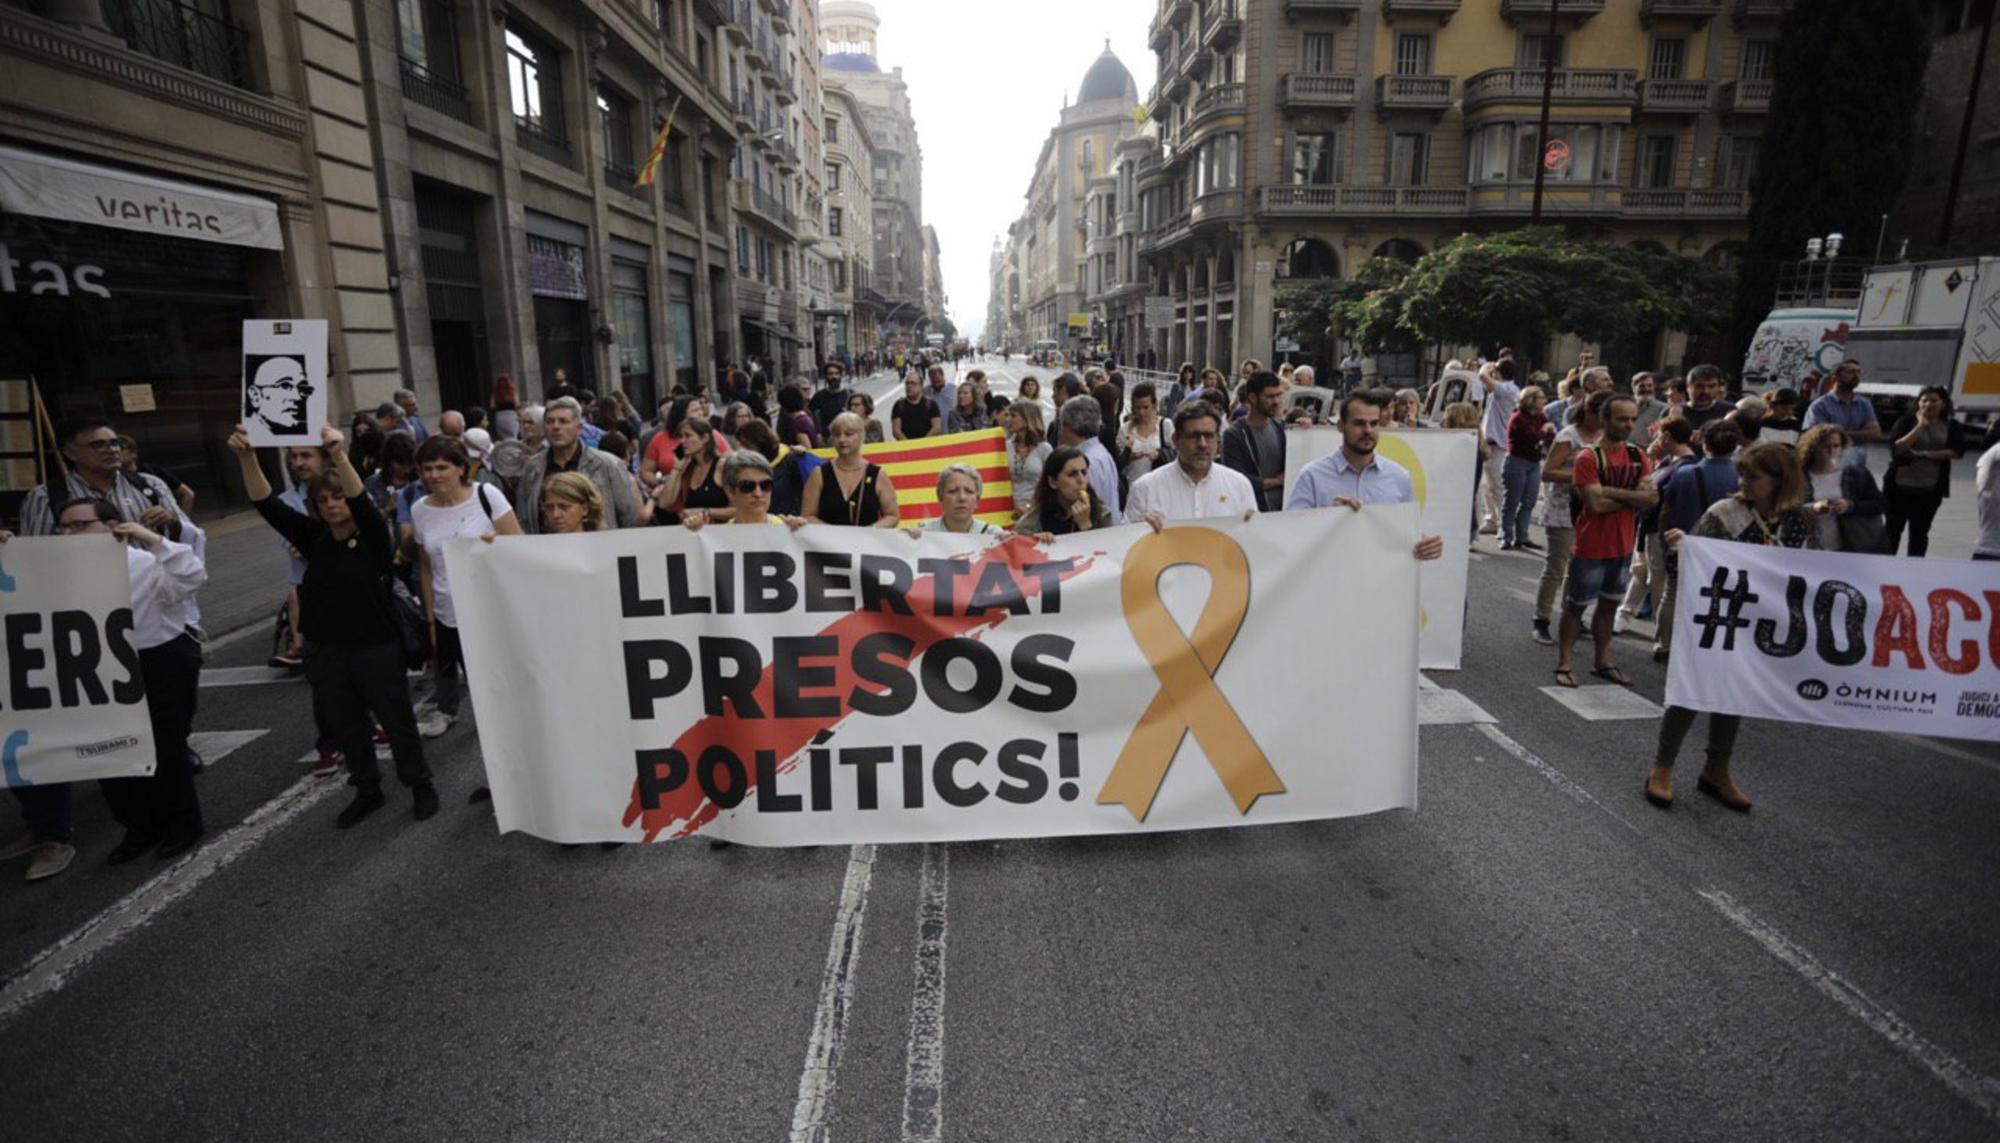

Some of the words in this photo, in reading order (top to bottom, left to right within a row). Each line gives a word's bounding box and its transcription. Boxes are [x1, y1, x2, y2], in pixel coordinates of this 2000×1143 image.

[95, 196, 222, 234] veritas
[0, 241, 112, 298] tas
[617, 550, 1075, 618] LLIBERTAT
[623, 632, 1078, 720] PRESOS
[1835, 682, 1936, 704] ÒMNIUM
[634, 729, 1080, 814] POLÍTICS!
